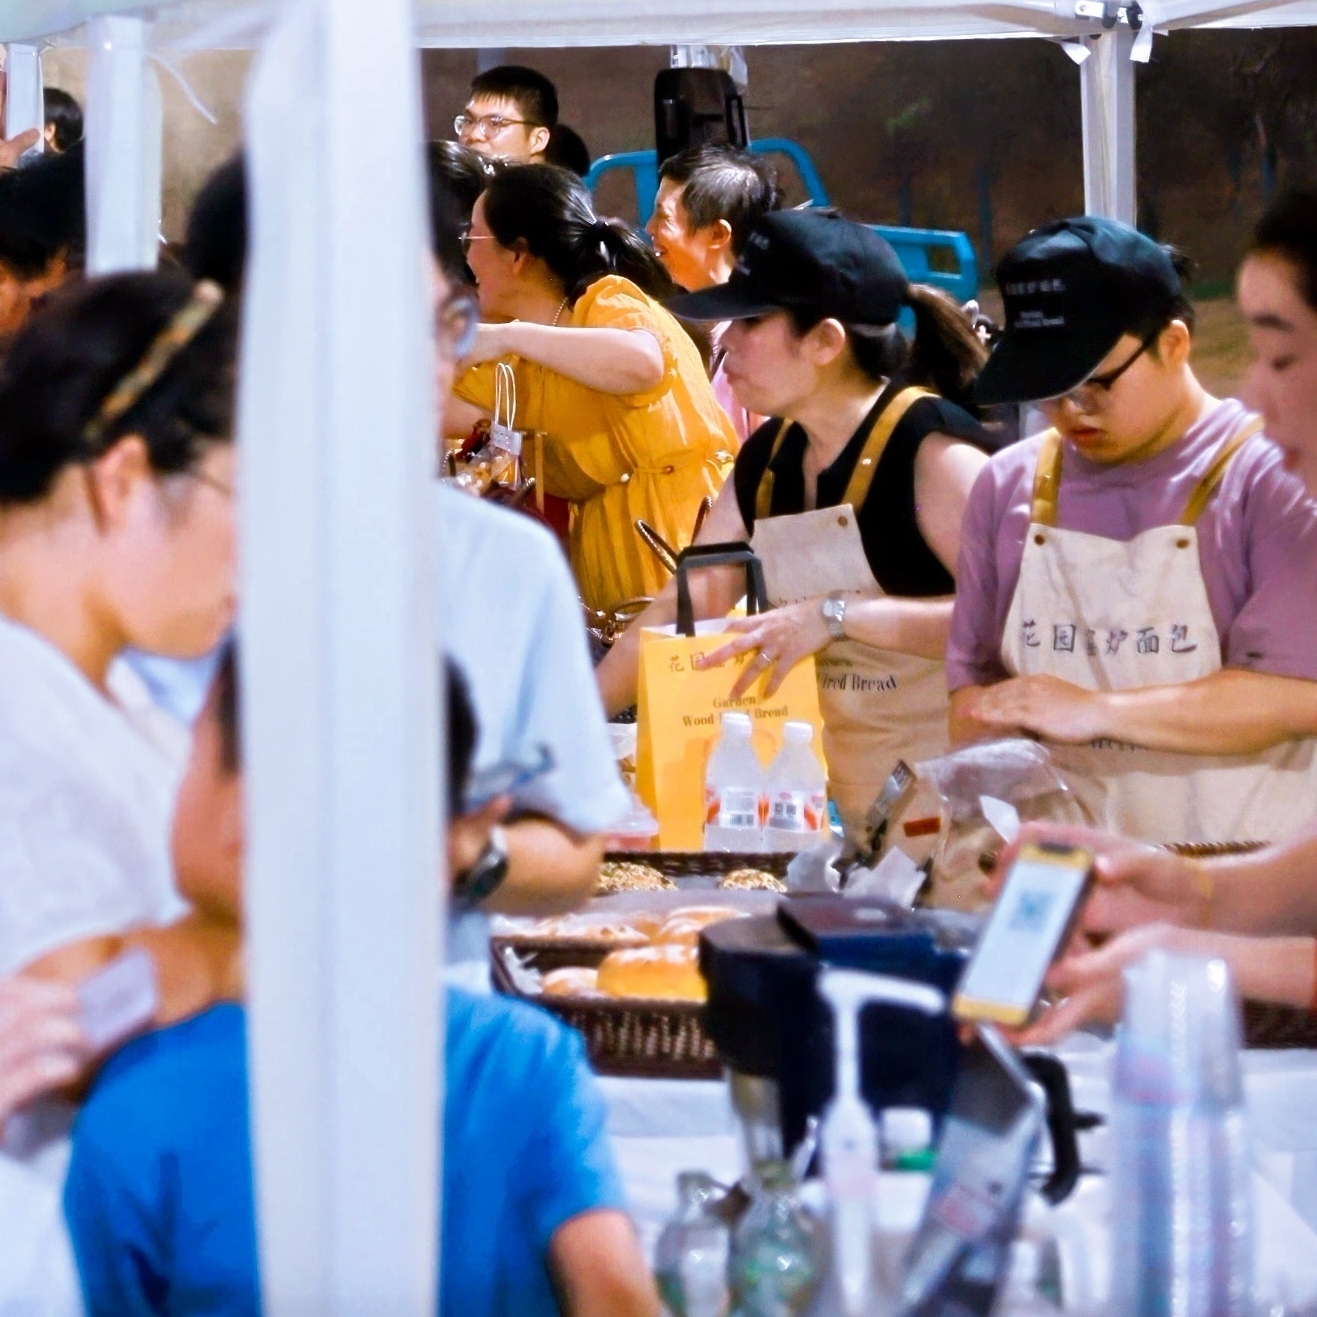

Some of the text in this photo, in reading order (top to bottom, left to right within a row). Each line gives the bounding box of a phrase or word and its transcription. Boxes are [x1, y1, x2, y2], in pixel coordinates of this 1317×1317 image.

[817, 673, 898, 692] ired Bread
[682, 713, 715, 727] Wood
[754, 705, 789, 720] Bread
